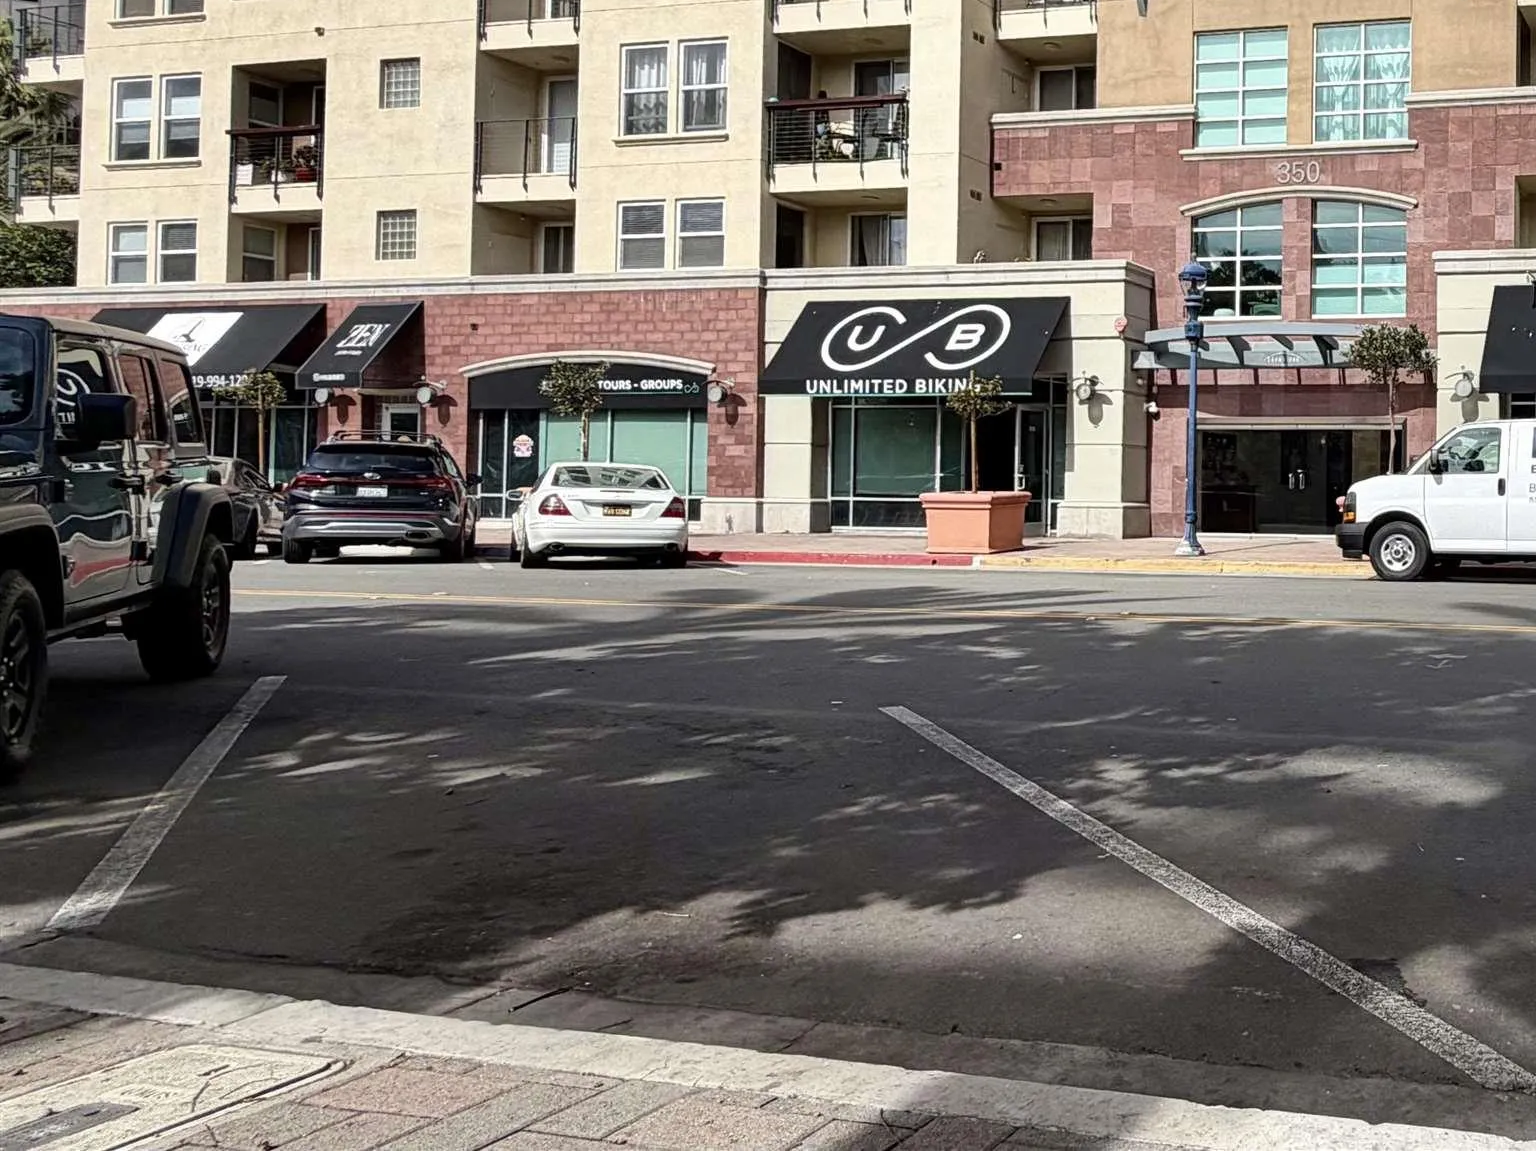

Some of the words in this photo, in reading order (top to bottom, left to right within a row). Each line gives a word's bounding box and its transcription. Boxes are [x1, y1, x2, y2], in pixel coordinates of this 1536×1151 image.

[1276, 161, 1320, 183] 350
[336, 323, 391, 348] ZEN
[597, 380, 632, 391] TOURS
[640, 379, 683, 391] GROUPS
[805, 378, 908, 394] UNLIMITED
